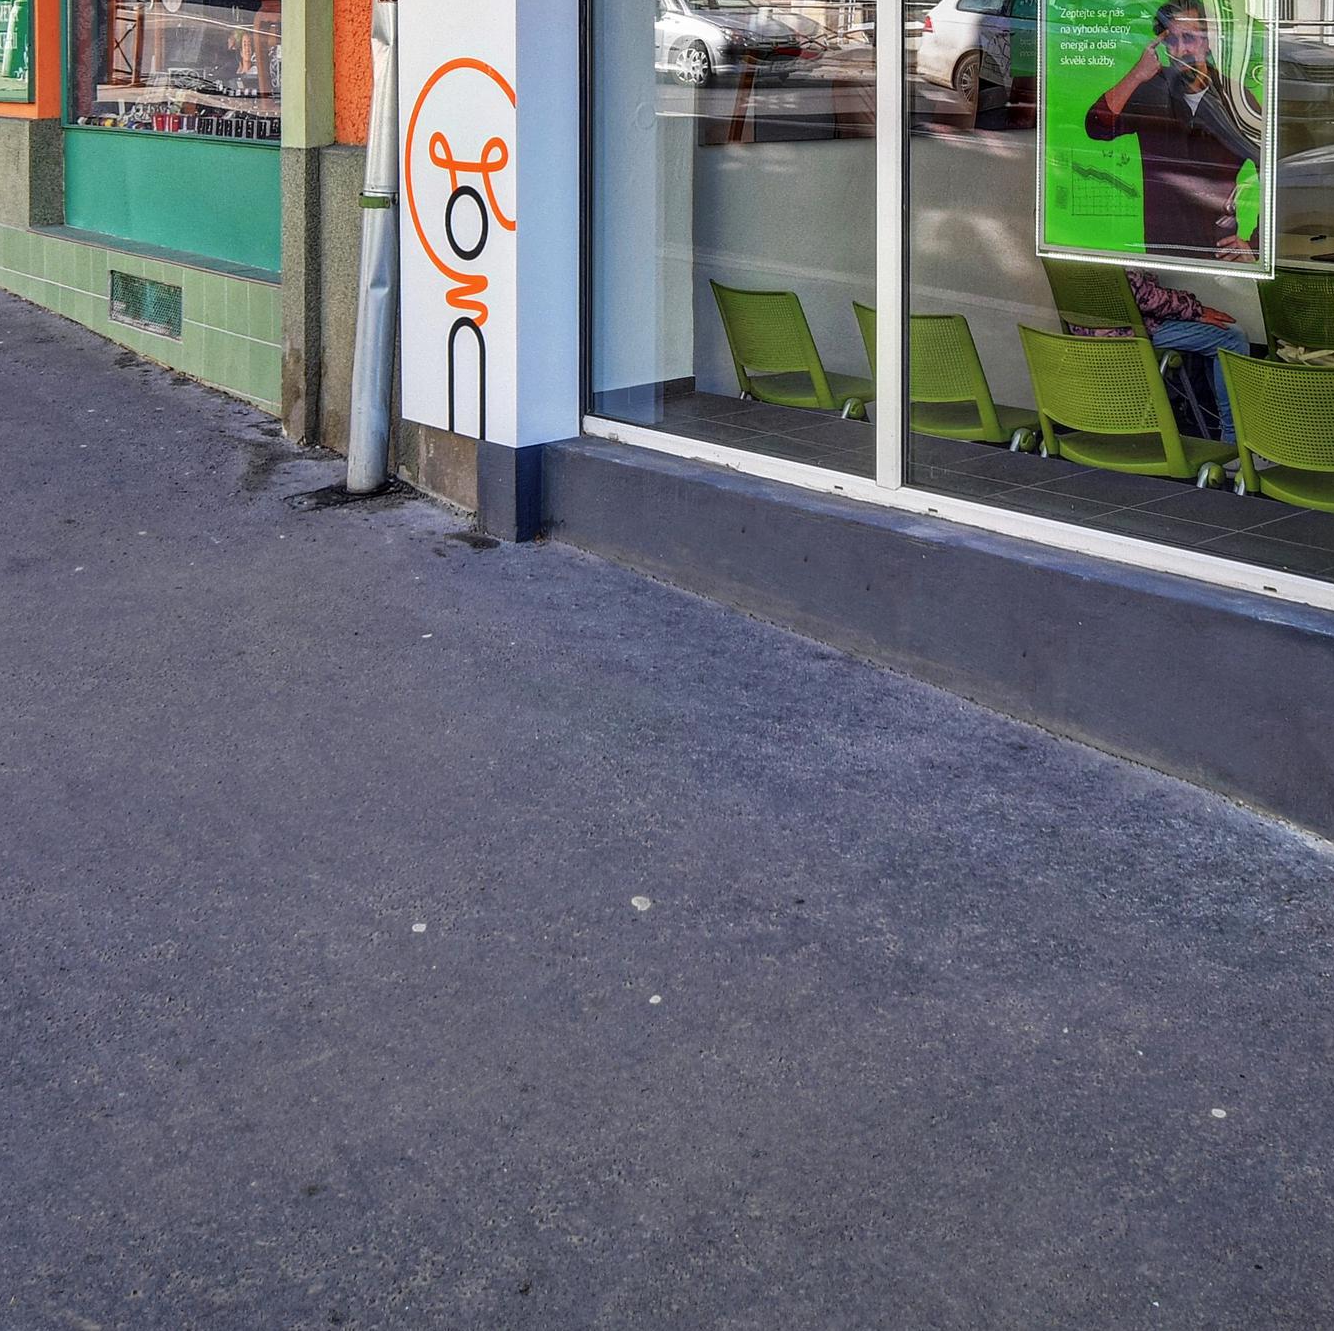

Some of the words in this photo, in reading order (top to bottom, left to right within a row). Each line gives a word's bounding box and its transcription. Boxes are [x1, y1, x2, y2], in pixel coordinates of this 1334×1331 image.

[1060, 8, 1095, 20] Zeptejte
[1097, 10, 1107, 18] se
[1109, 8, 1125, 18] nás
[1060, 25, 1070, 34] na
[1072, 23, 1109, 35] výhodné
[1110, 25, 1131, 36] ceny
[1089, 42, 1095, 50] a
[1096, 39, 1117, 50] další
[1060, 56, 1087, 66] skvělé
[1087, 56, 1116, 68] služby.
